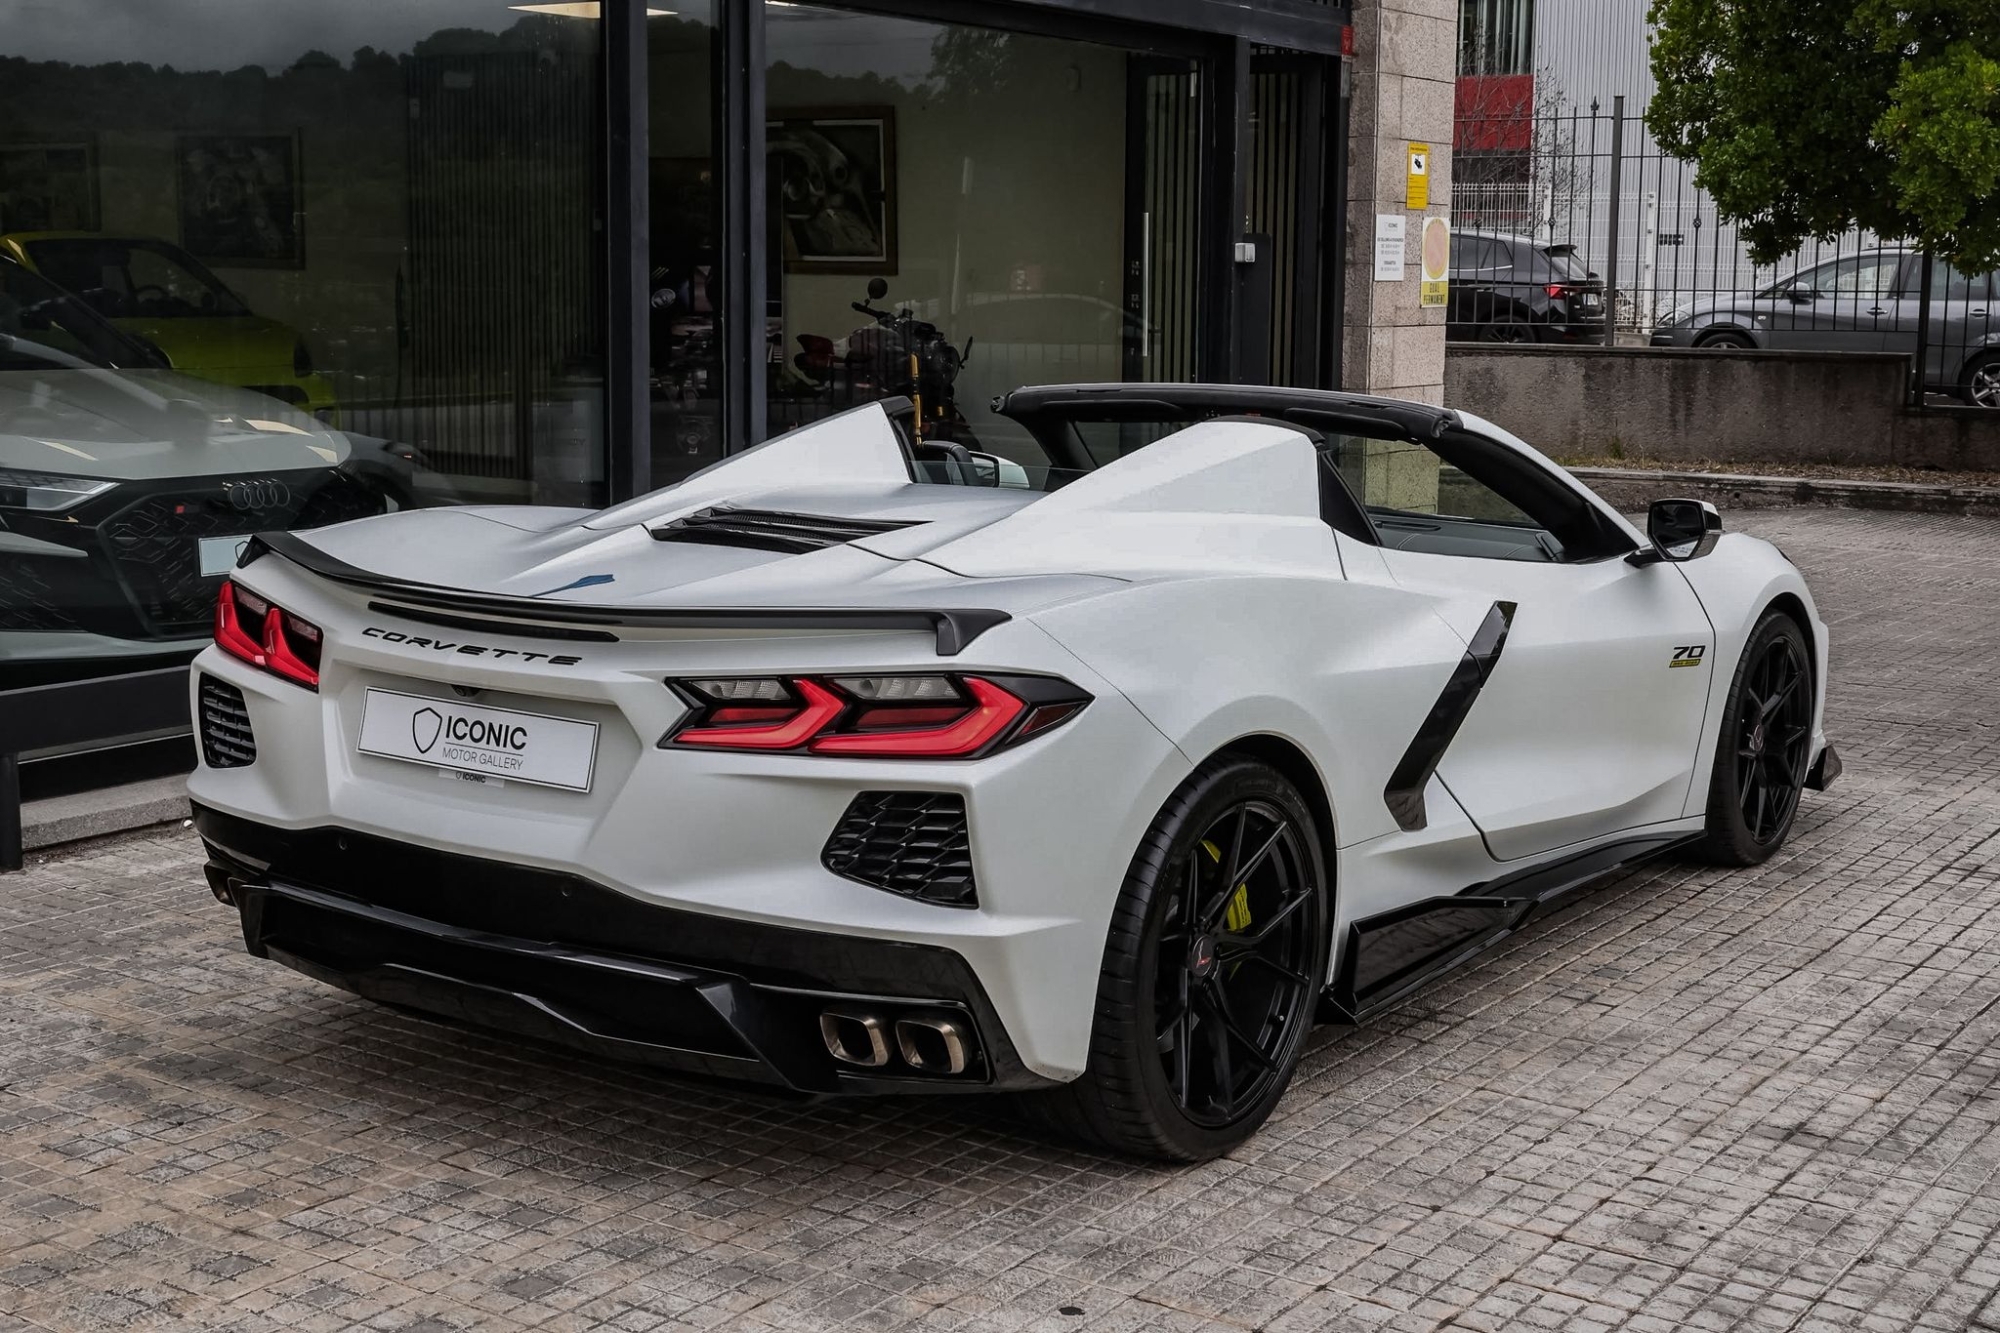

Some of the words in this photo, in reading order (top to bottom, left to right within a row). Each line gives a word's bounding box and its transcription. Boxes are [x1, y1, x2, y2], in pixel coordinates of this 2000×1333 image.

[362, 627, 583, 666] CORVETTE
[1673, 645, 1706, 659] 70
[445, 715, 528, 750] ICONIC
[442, 747, 478, 763] MOTOR
[479, 753, 524, 770] GALLERY
[462, 772, 487, 784] ICONIC
